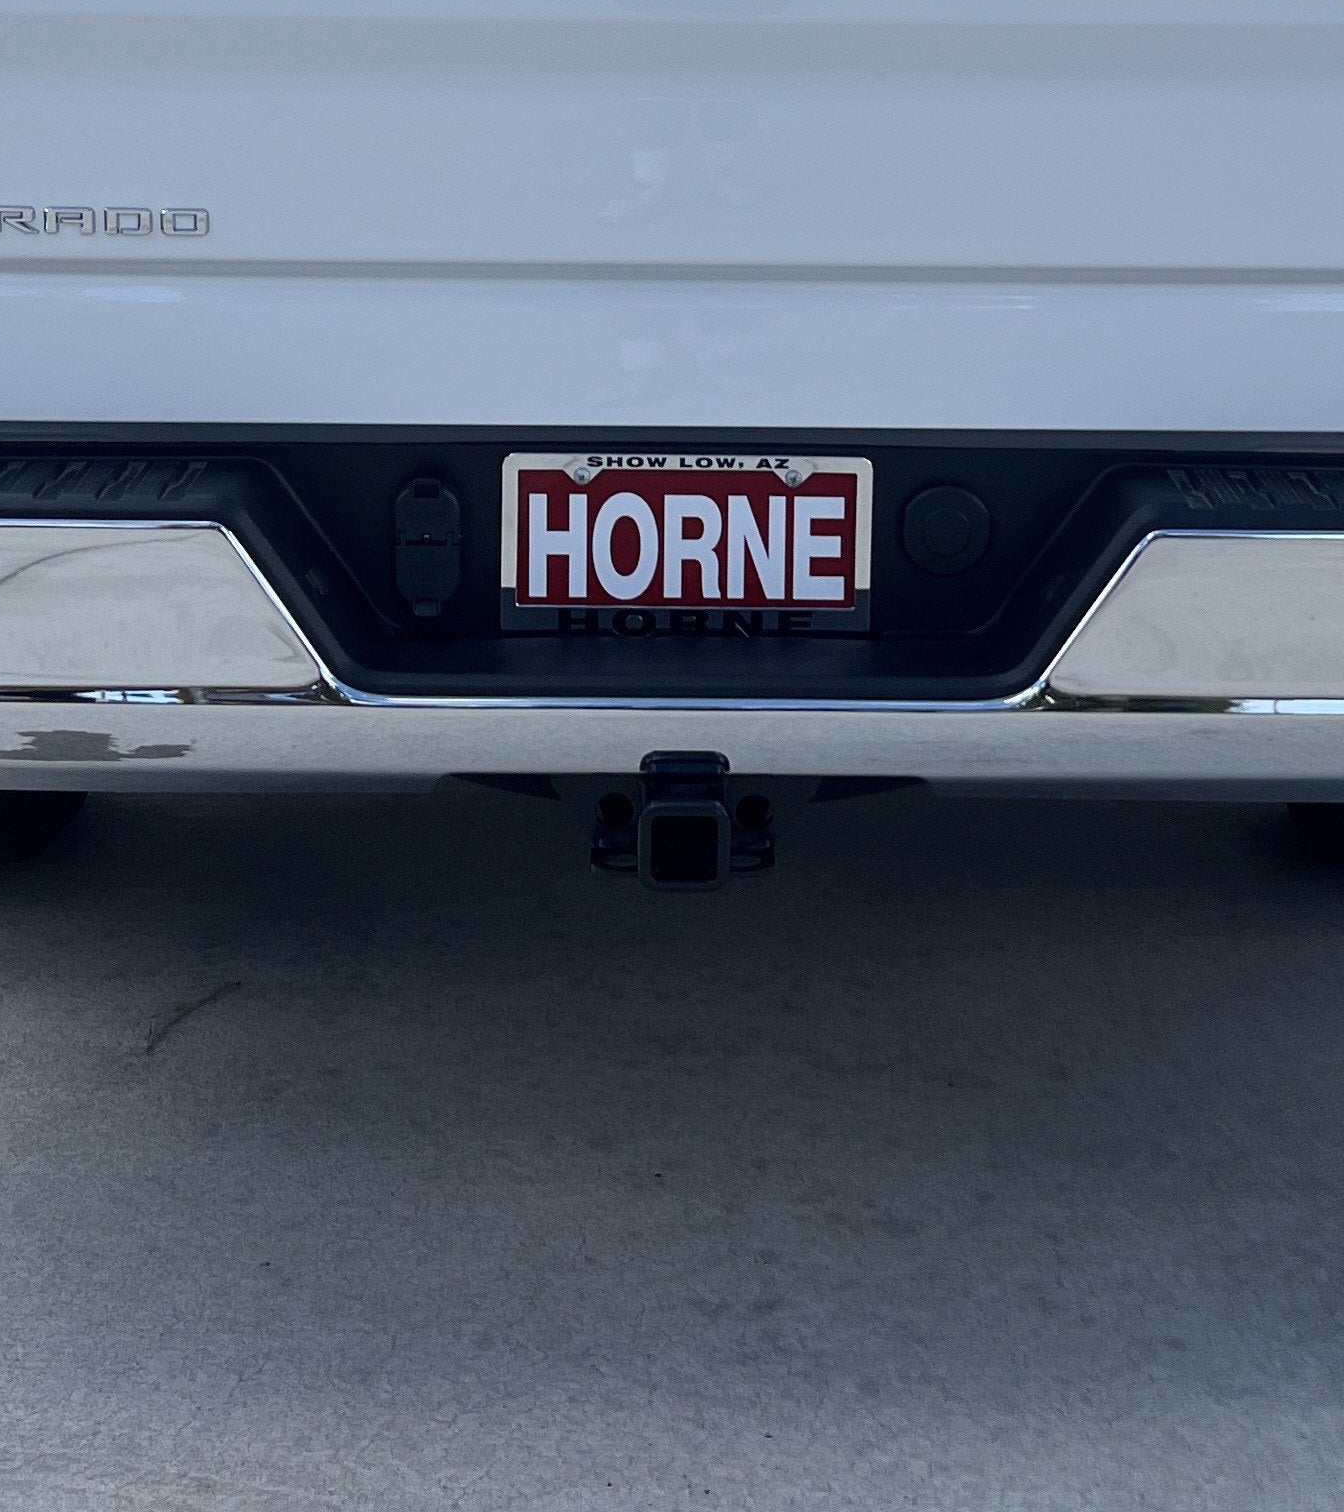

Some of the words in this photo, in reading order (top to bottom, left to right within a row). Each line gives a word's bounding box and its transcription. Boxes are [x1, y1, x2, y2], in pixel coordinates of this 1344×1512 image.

[587, 455, 667, 469] SHOW
[679, 457, 745, 470] LOW,
[756, 458, 790, 470] AZ
[528, 491, 846, 601] HORNE
[557, 609, 814, 638] HORNE
